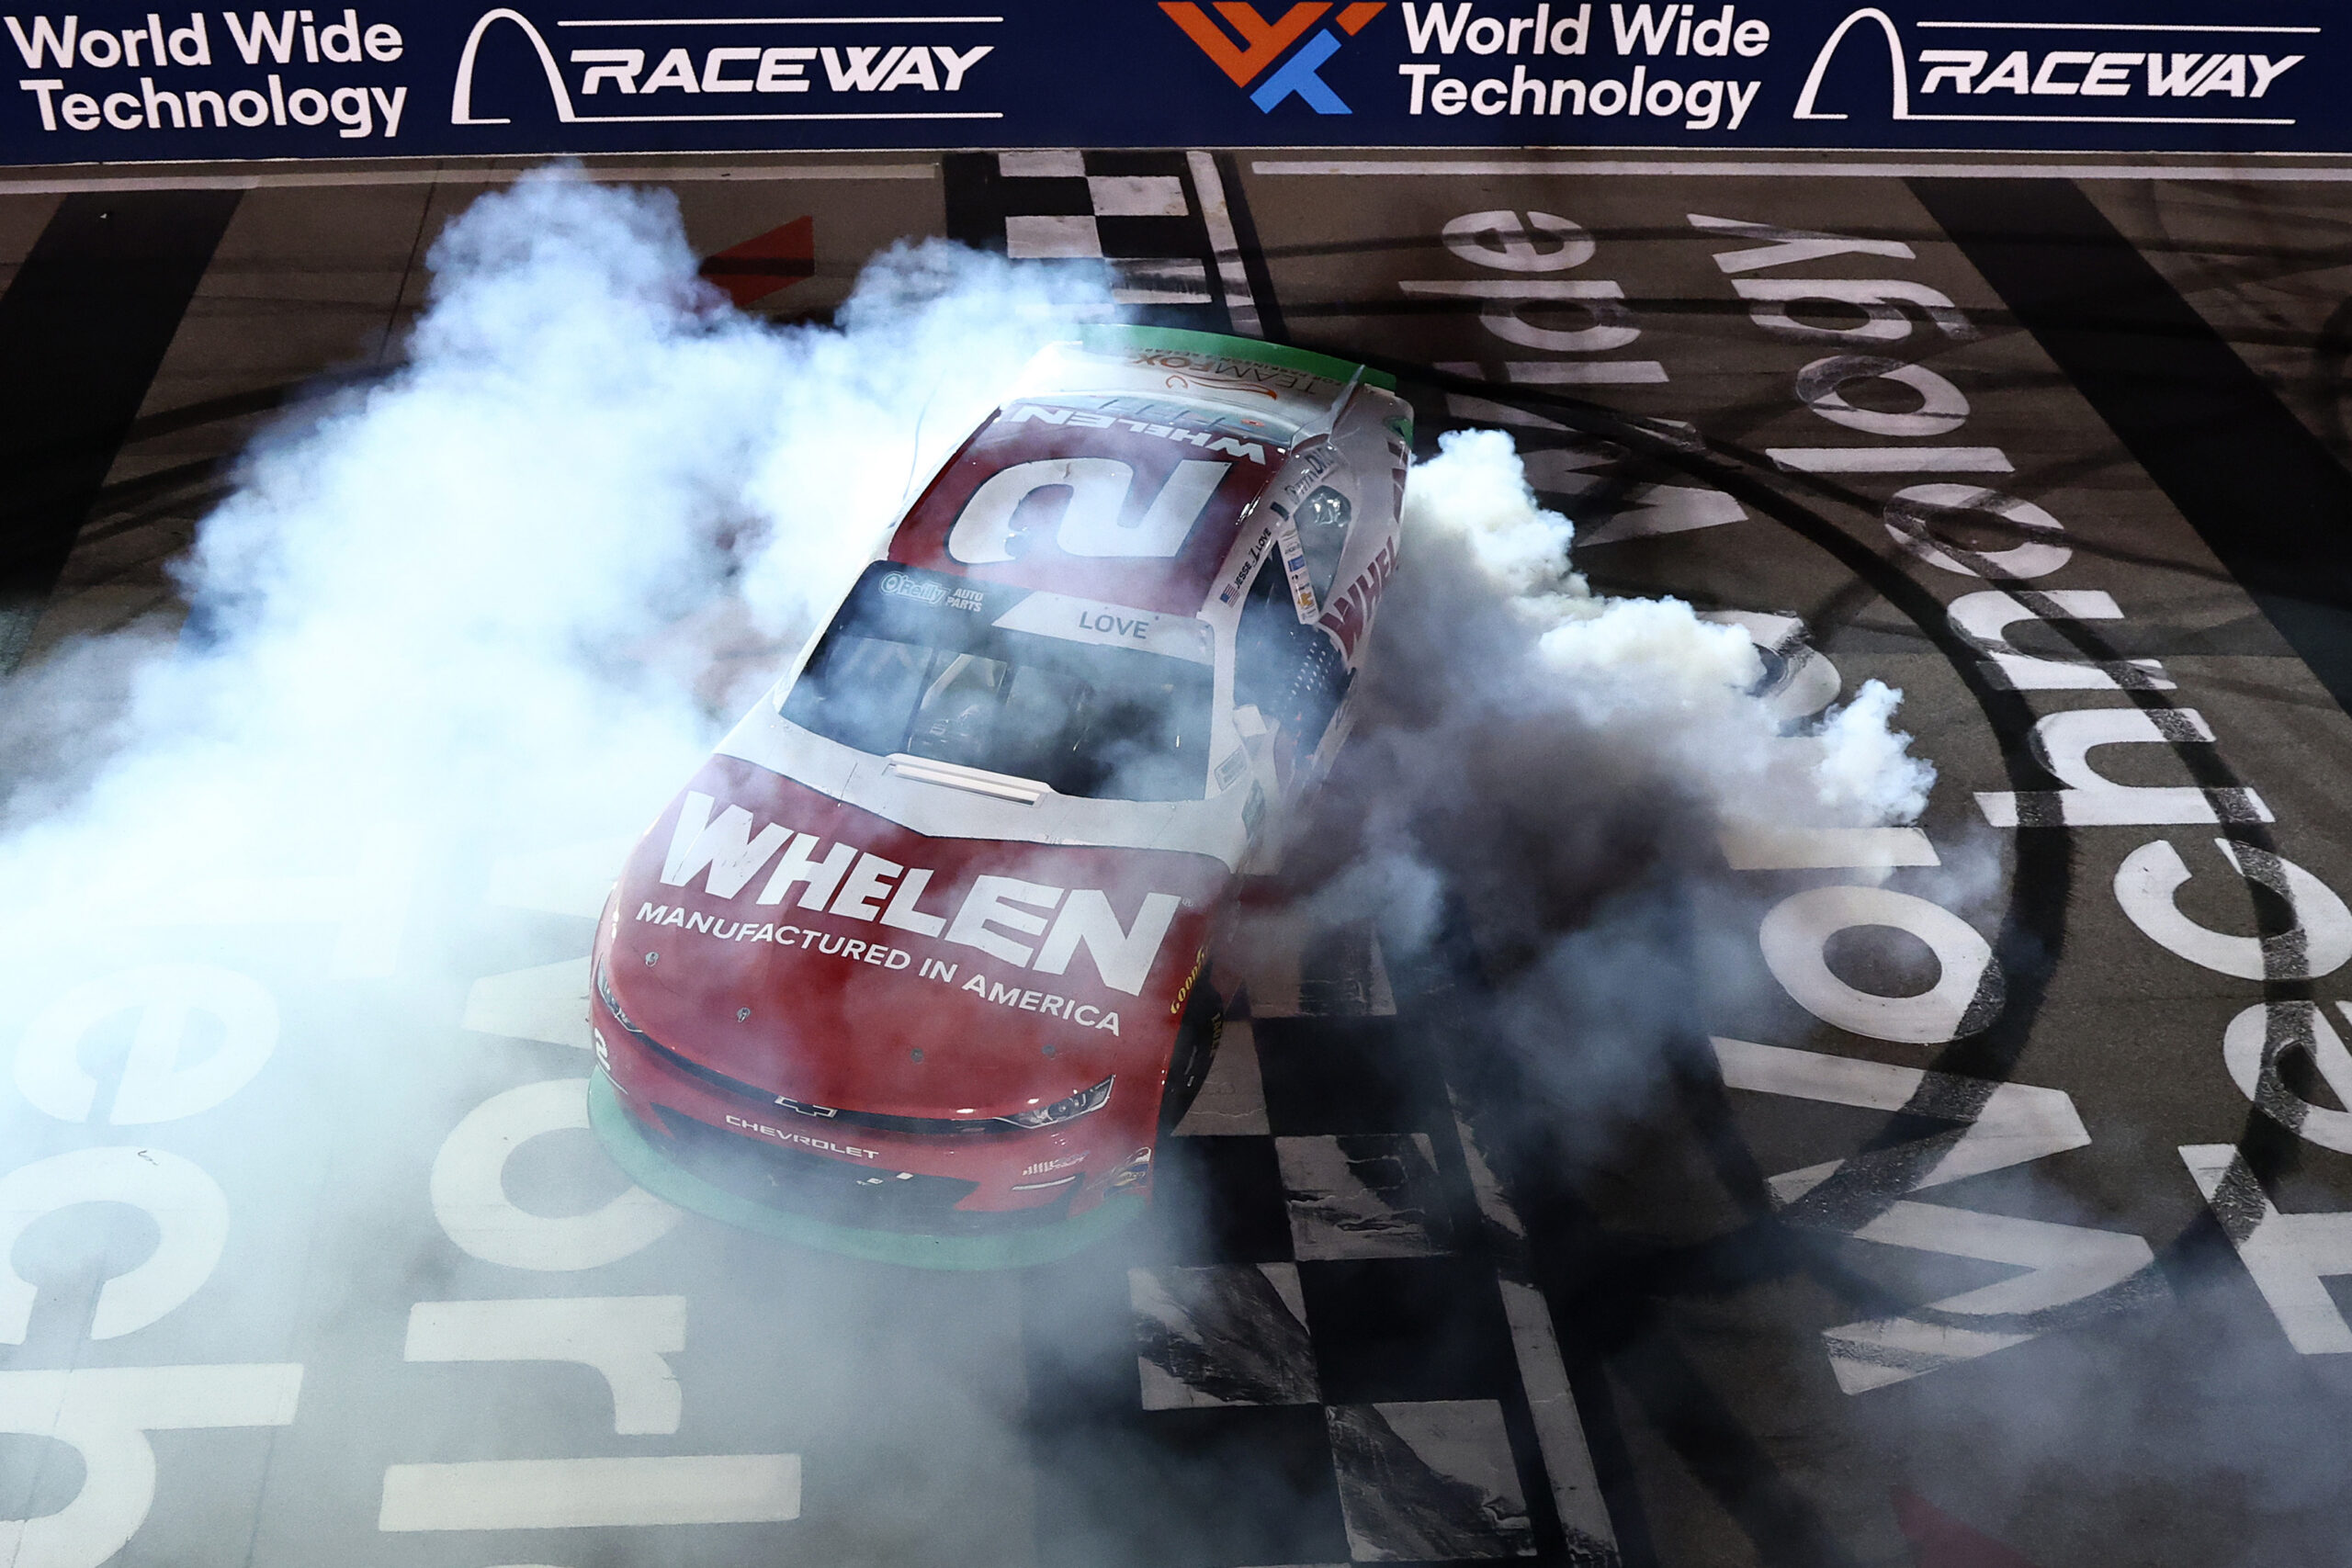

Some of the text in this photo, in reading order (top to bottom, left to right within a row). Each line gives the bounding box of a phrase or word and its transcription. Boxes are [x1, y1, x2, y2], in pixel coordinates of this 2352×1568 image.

[4, 9, 403, 68] World Wide
[1401, 2, 1770, 57] World Wide
[571, 46, 994, 95] RACEWAY
[1399, 63, 1761, 130] Technology
[1919, 50, 2305, 98] RACEWAY
[19, 74, 408, 139] Technology
[1010, 405, 1266, 465] WHELEN
[946, 457, 1233, 564] 2
[1232, 562, 1252, 590] JESSE
[1255, 527, 1272, 552] LOVE
[945, 596, 984, 614] PARTS
[953, 587, 985, 603] AUTO
[1078, 610, 1150, 640] LOVE
[660, 790, 1182, 996] WHELEN
[636, 901, 1121, 1037] MANUFACTURED IN AMERICA
[725, 1115, 879, 1160] CHEVROLET
